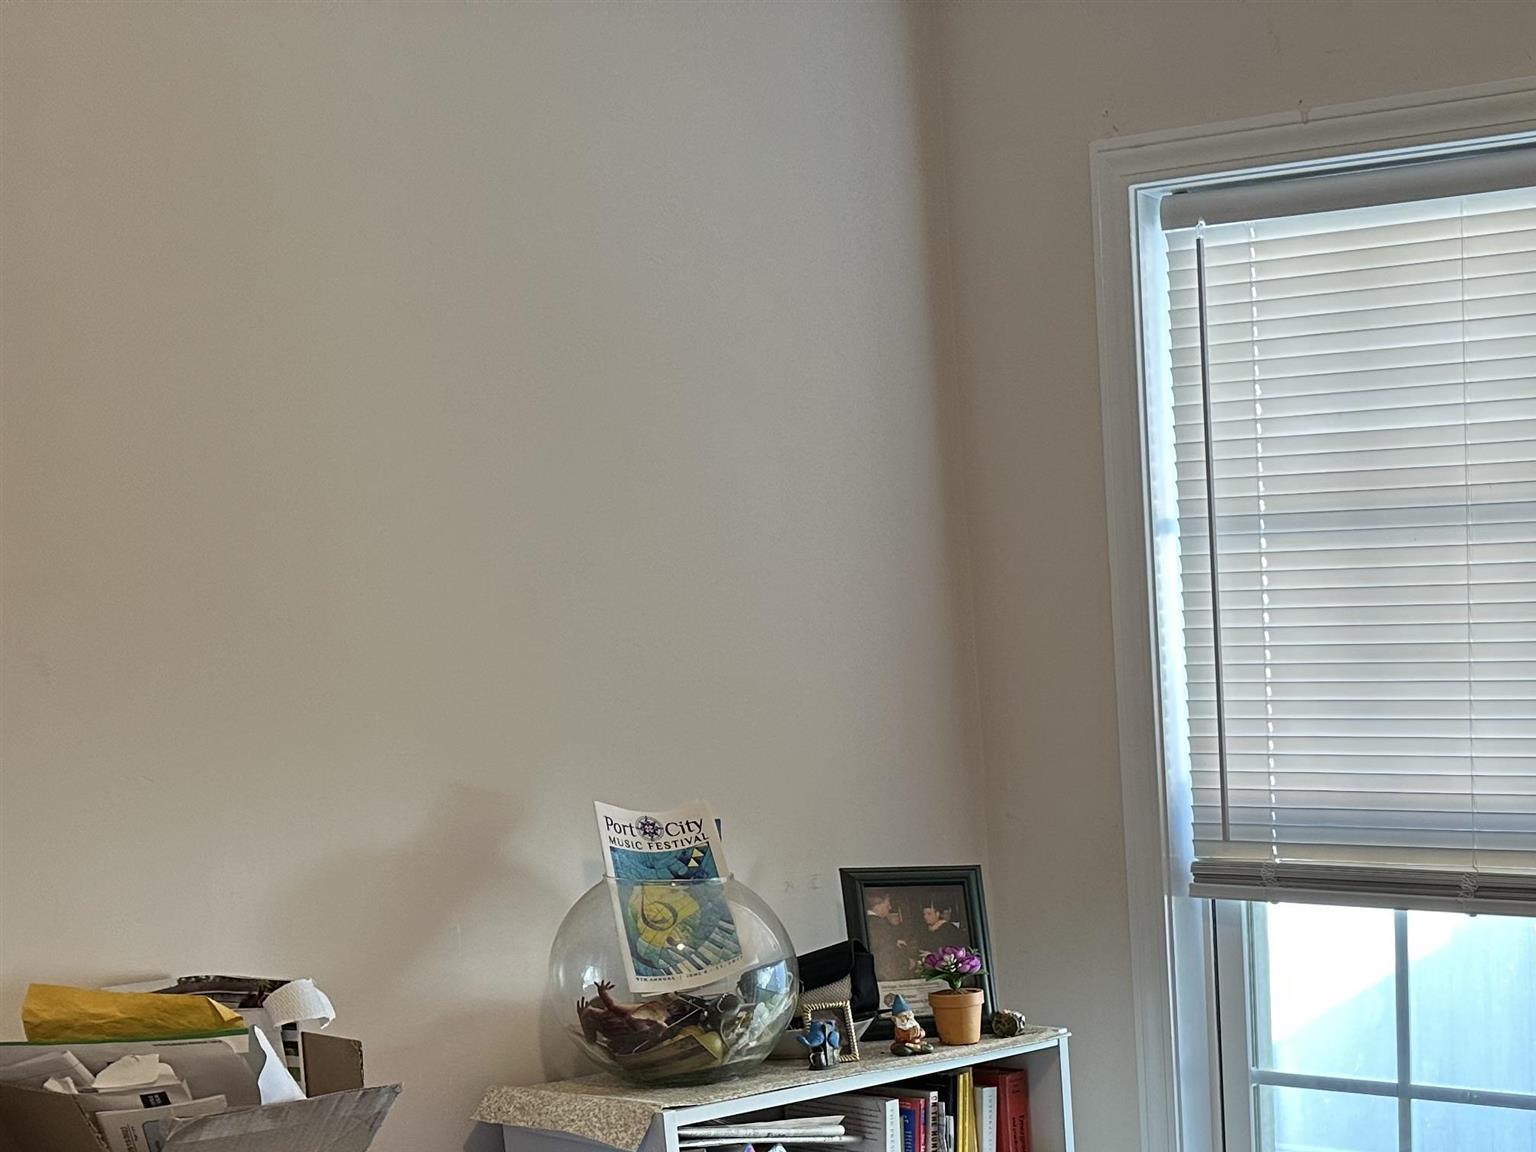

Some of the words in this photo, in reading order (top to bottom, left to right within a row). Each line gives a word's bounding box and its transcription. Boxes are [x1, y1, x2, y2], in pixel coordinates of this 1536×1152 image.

[604, 815, 638, 838] Port
[665, 818, 703, 837] City
[608, 835, 643, 851] MUSIC
[648, 833, 709, 851] FESTIVAL
